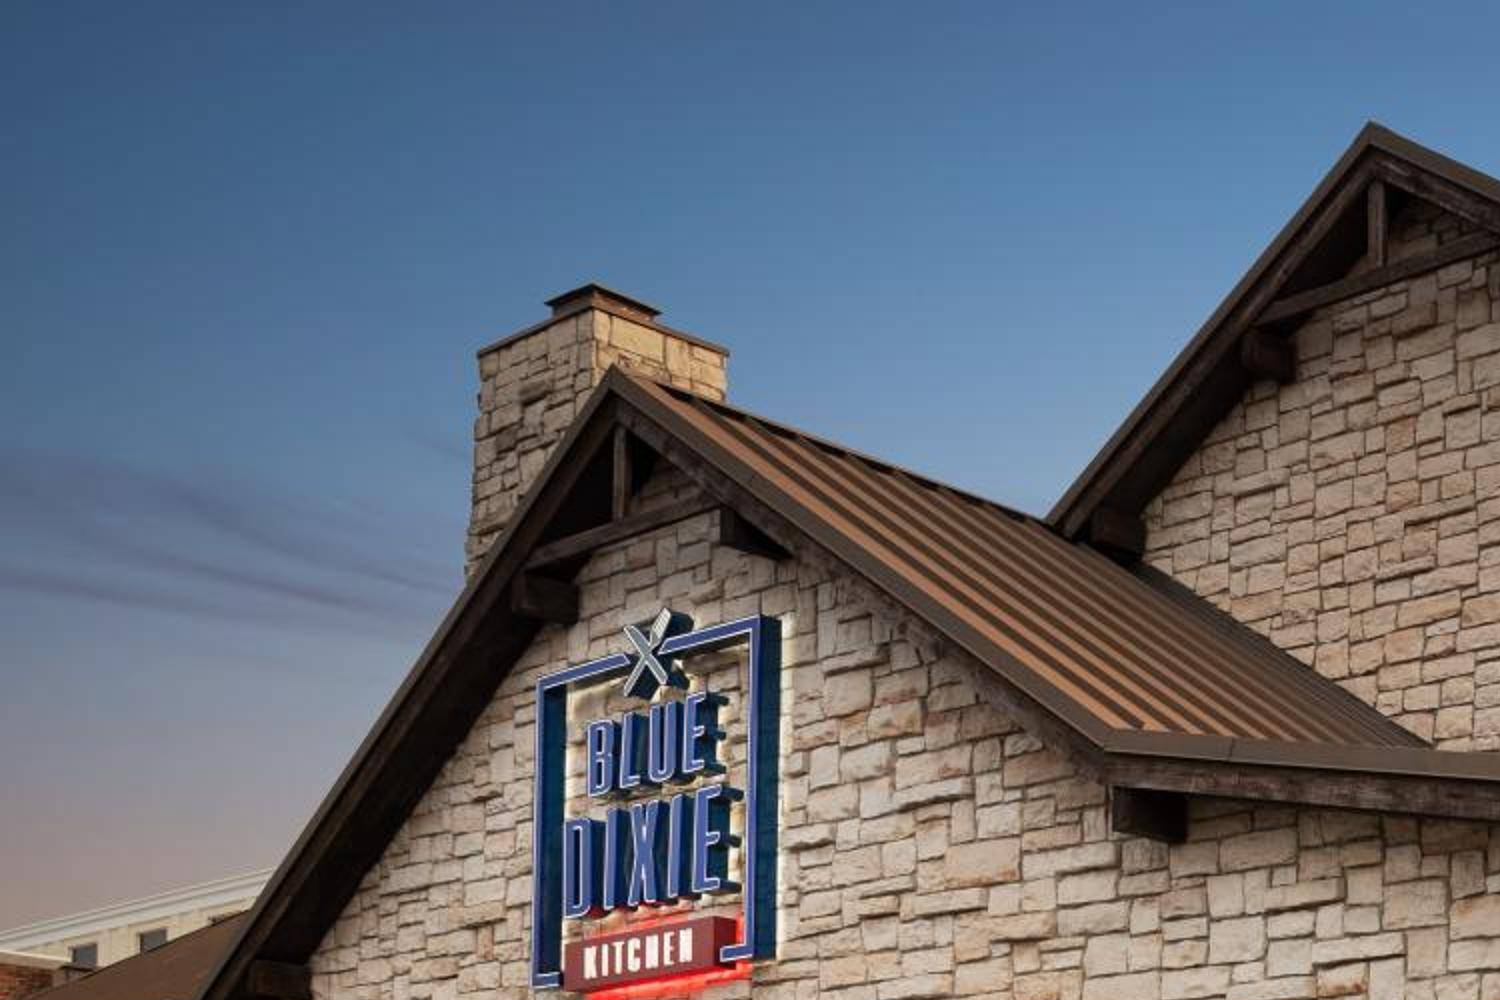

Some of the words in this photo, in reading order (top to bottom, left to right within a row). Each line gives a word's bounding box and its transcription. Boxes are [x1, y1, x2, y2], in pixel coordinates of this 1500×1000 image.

[587, 691, 708, 798] BLUE
[563, 784, 723, 919] DIXIE
[583, 927, 693, 979] KITCHEN
